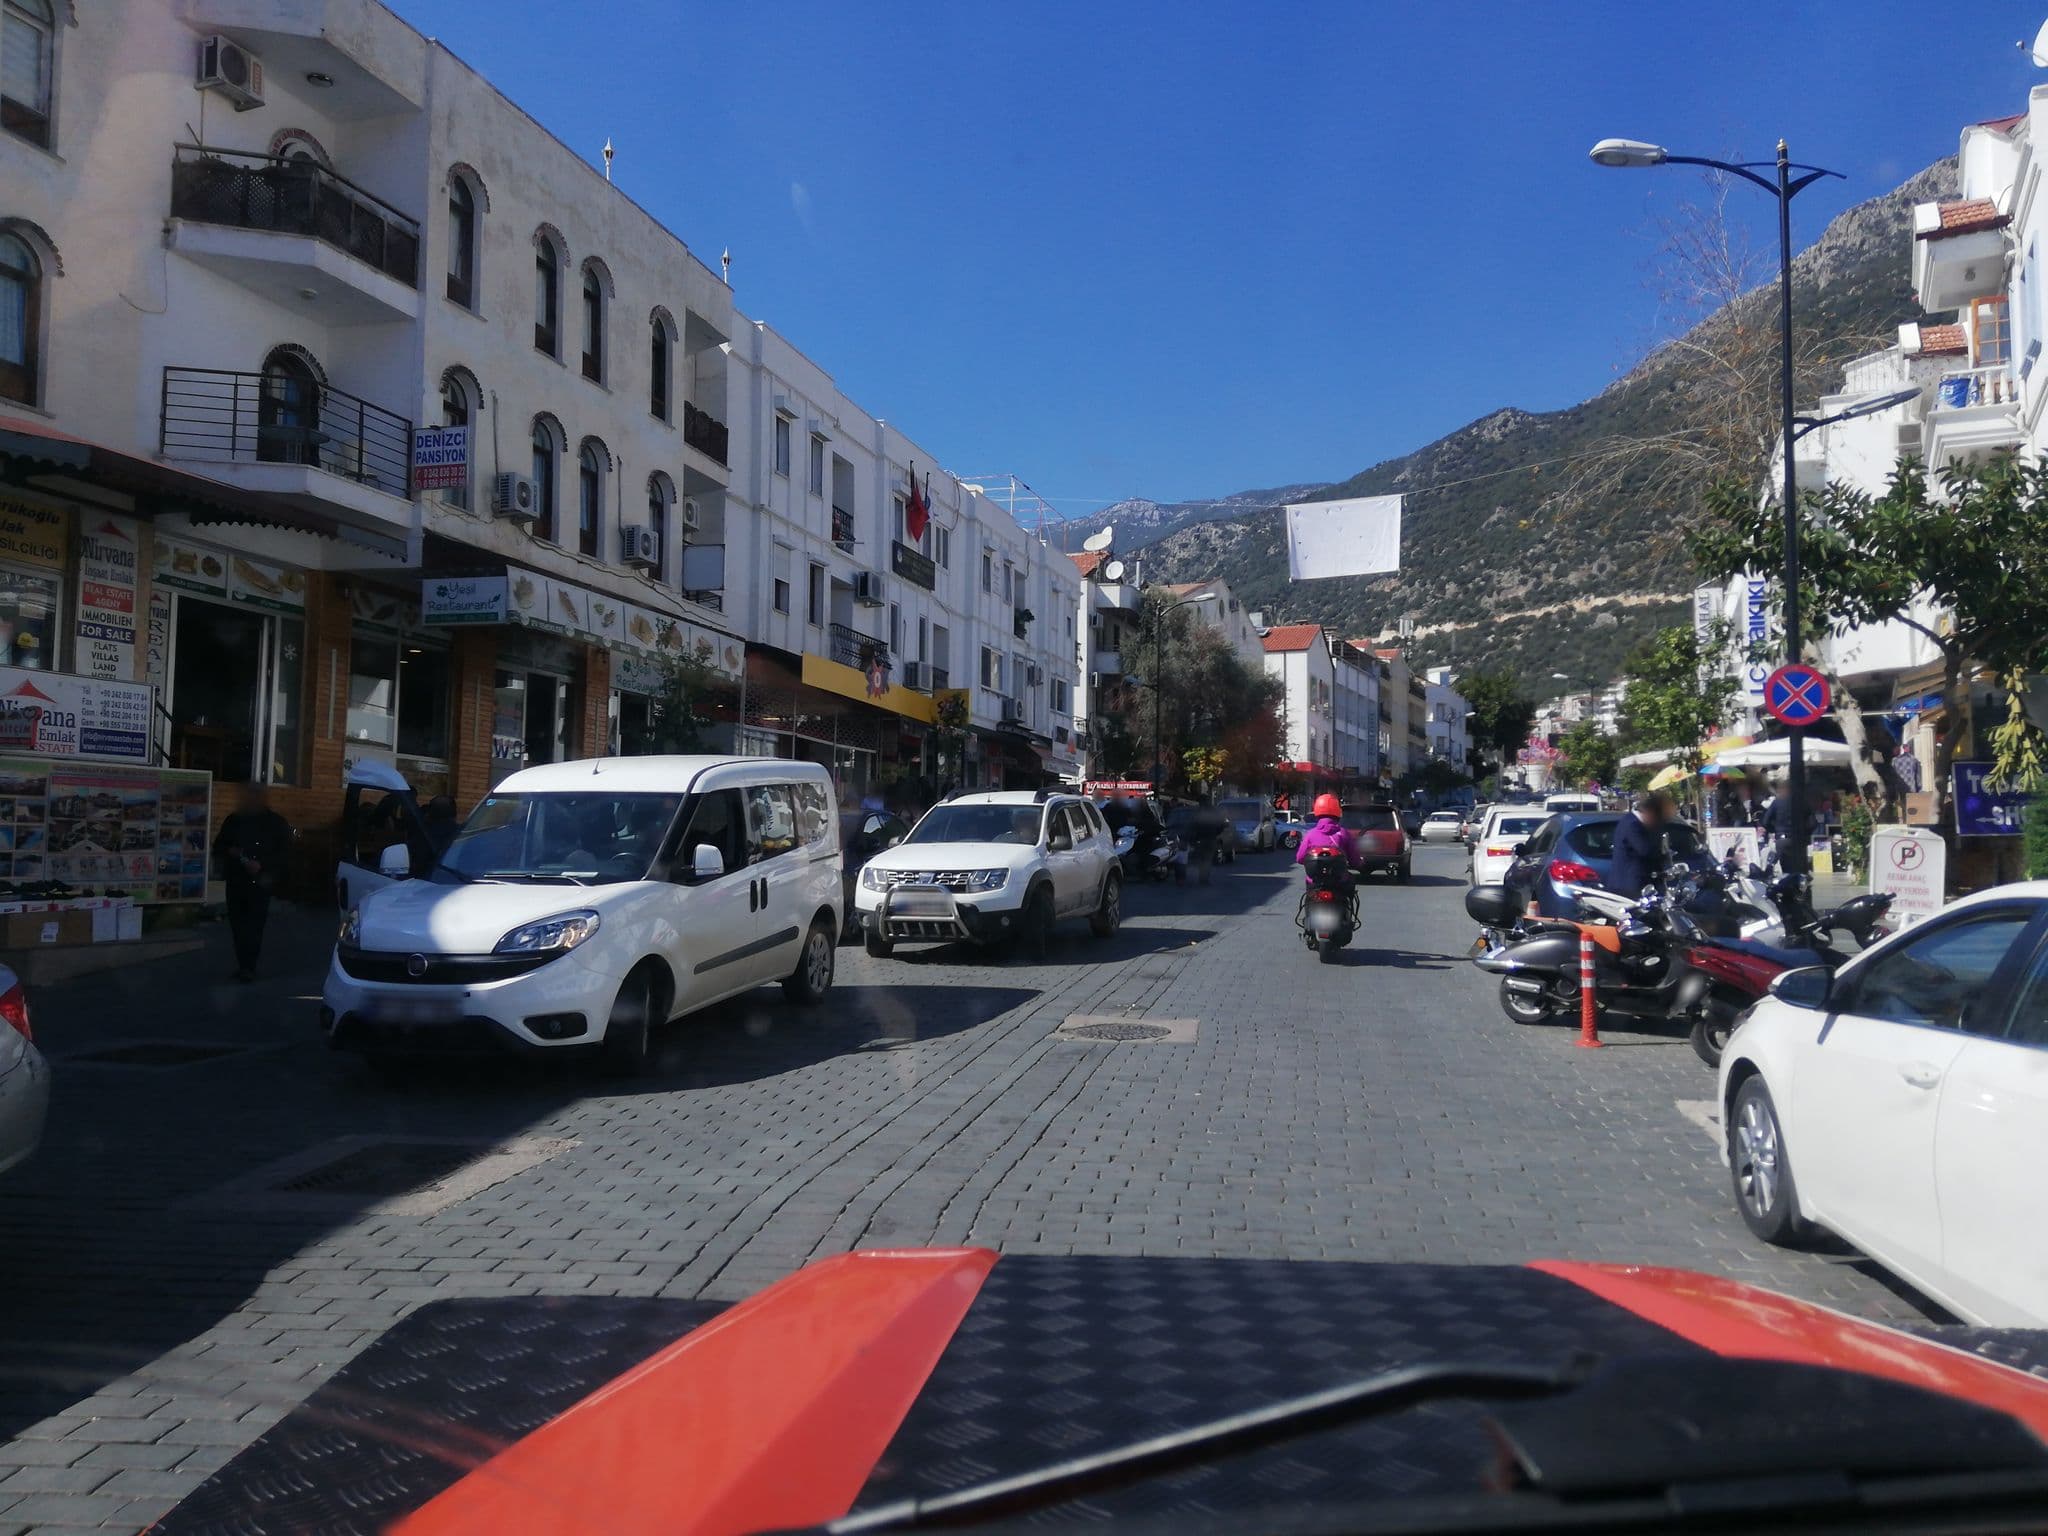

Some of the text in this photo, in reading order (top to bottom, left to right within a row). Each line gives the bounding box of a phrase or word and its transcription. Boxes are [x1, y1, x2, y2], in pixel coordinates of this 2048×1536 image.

[416, 429, 466, 448] DENİZCİ
[416, 447, 466, 464] PANSİYON
[80, 534, 134, 567] Nirvana
[85, 584, 133, 601] REAL ESTATE
[81, 609, 132, 627] IMMOBILIEN
[81, 624, 132, 642] FOR SALE
[1747, 580, 1767, 695] LC aikiki
[94, 641, 118, 652] FLATS
[91, 651, 119, 662] VILLAS
[93, 662, 116, 672] LAND
[39, 728, 76, 744] Emlak
